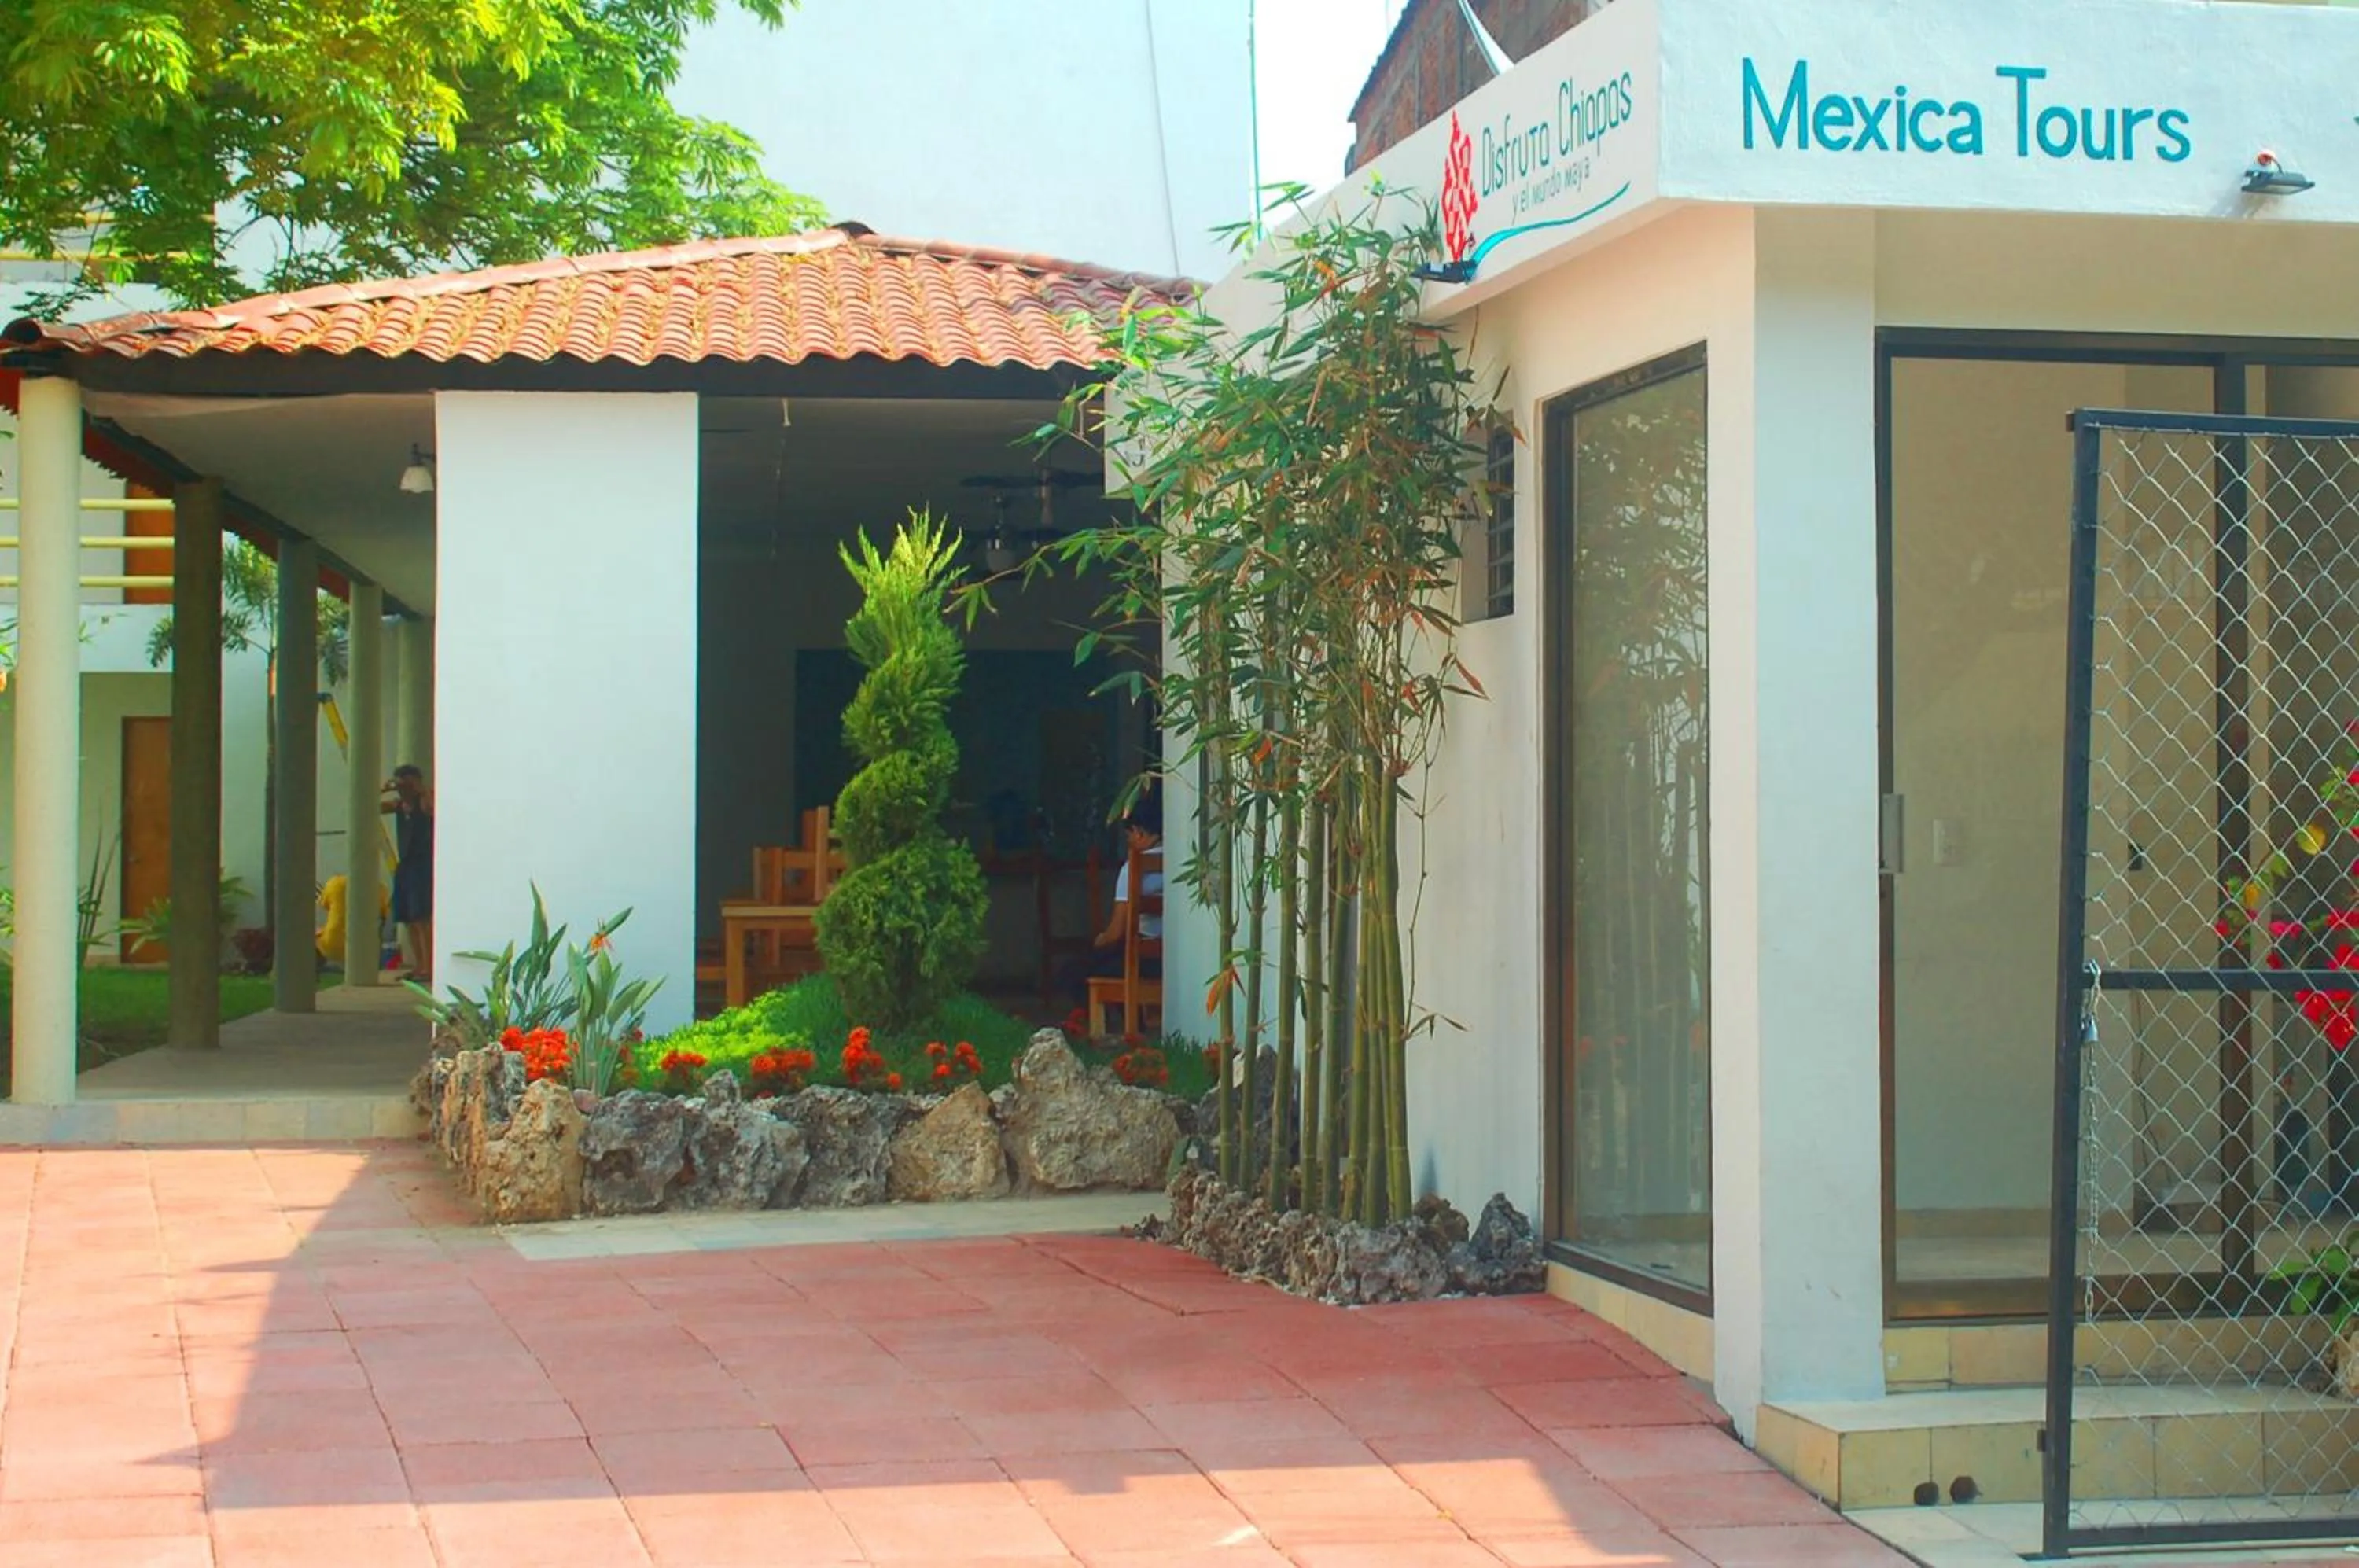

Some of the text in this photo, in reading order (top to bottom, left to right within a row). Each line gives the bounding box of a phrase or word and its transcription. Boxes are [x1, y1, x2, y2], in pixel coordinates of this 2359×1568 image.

[1481, 71, 1632, 198] Disfruta Chiapas
[1742, 57, 2192, 163] Mexica Tours
